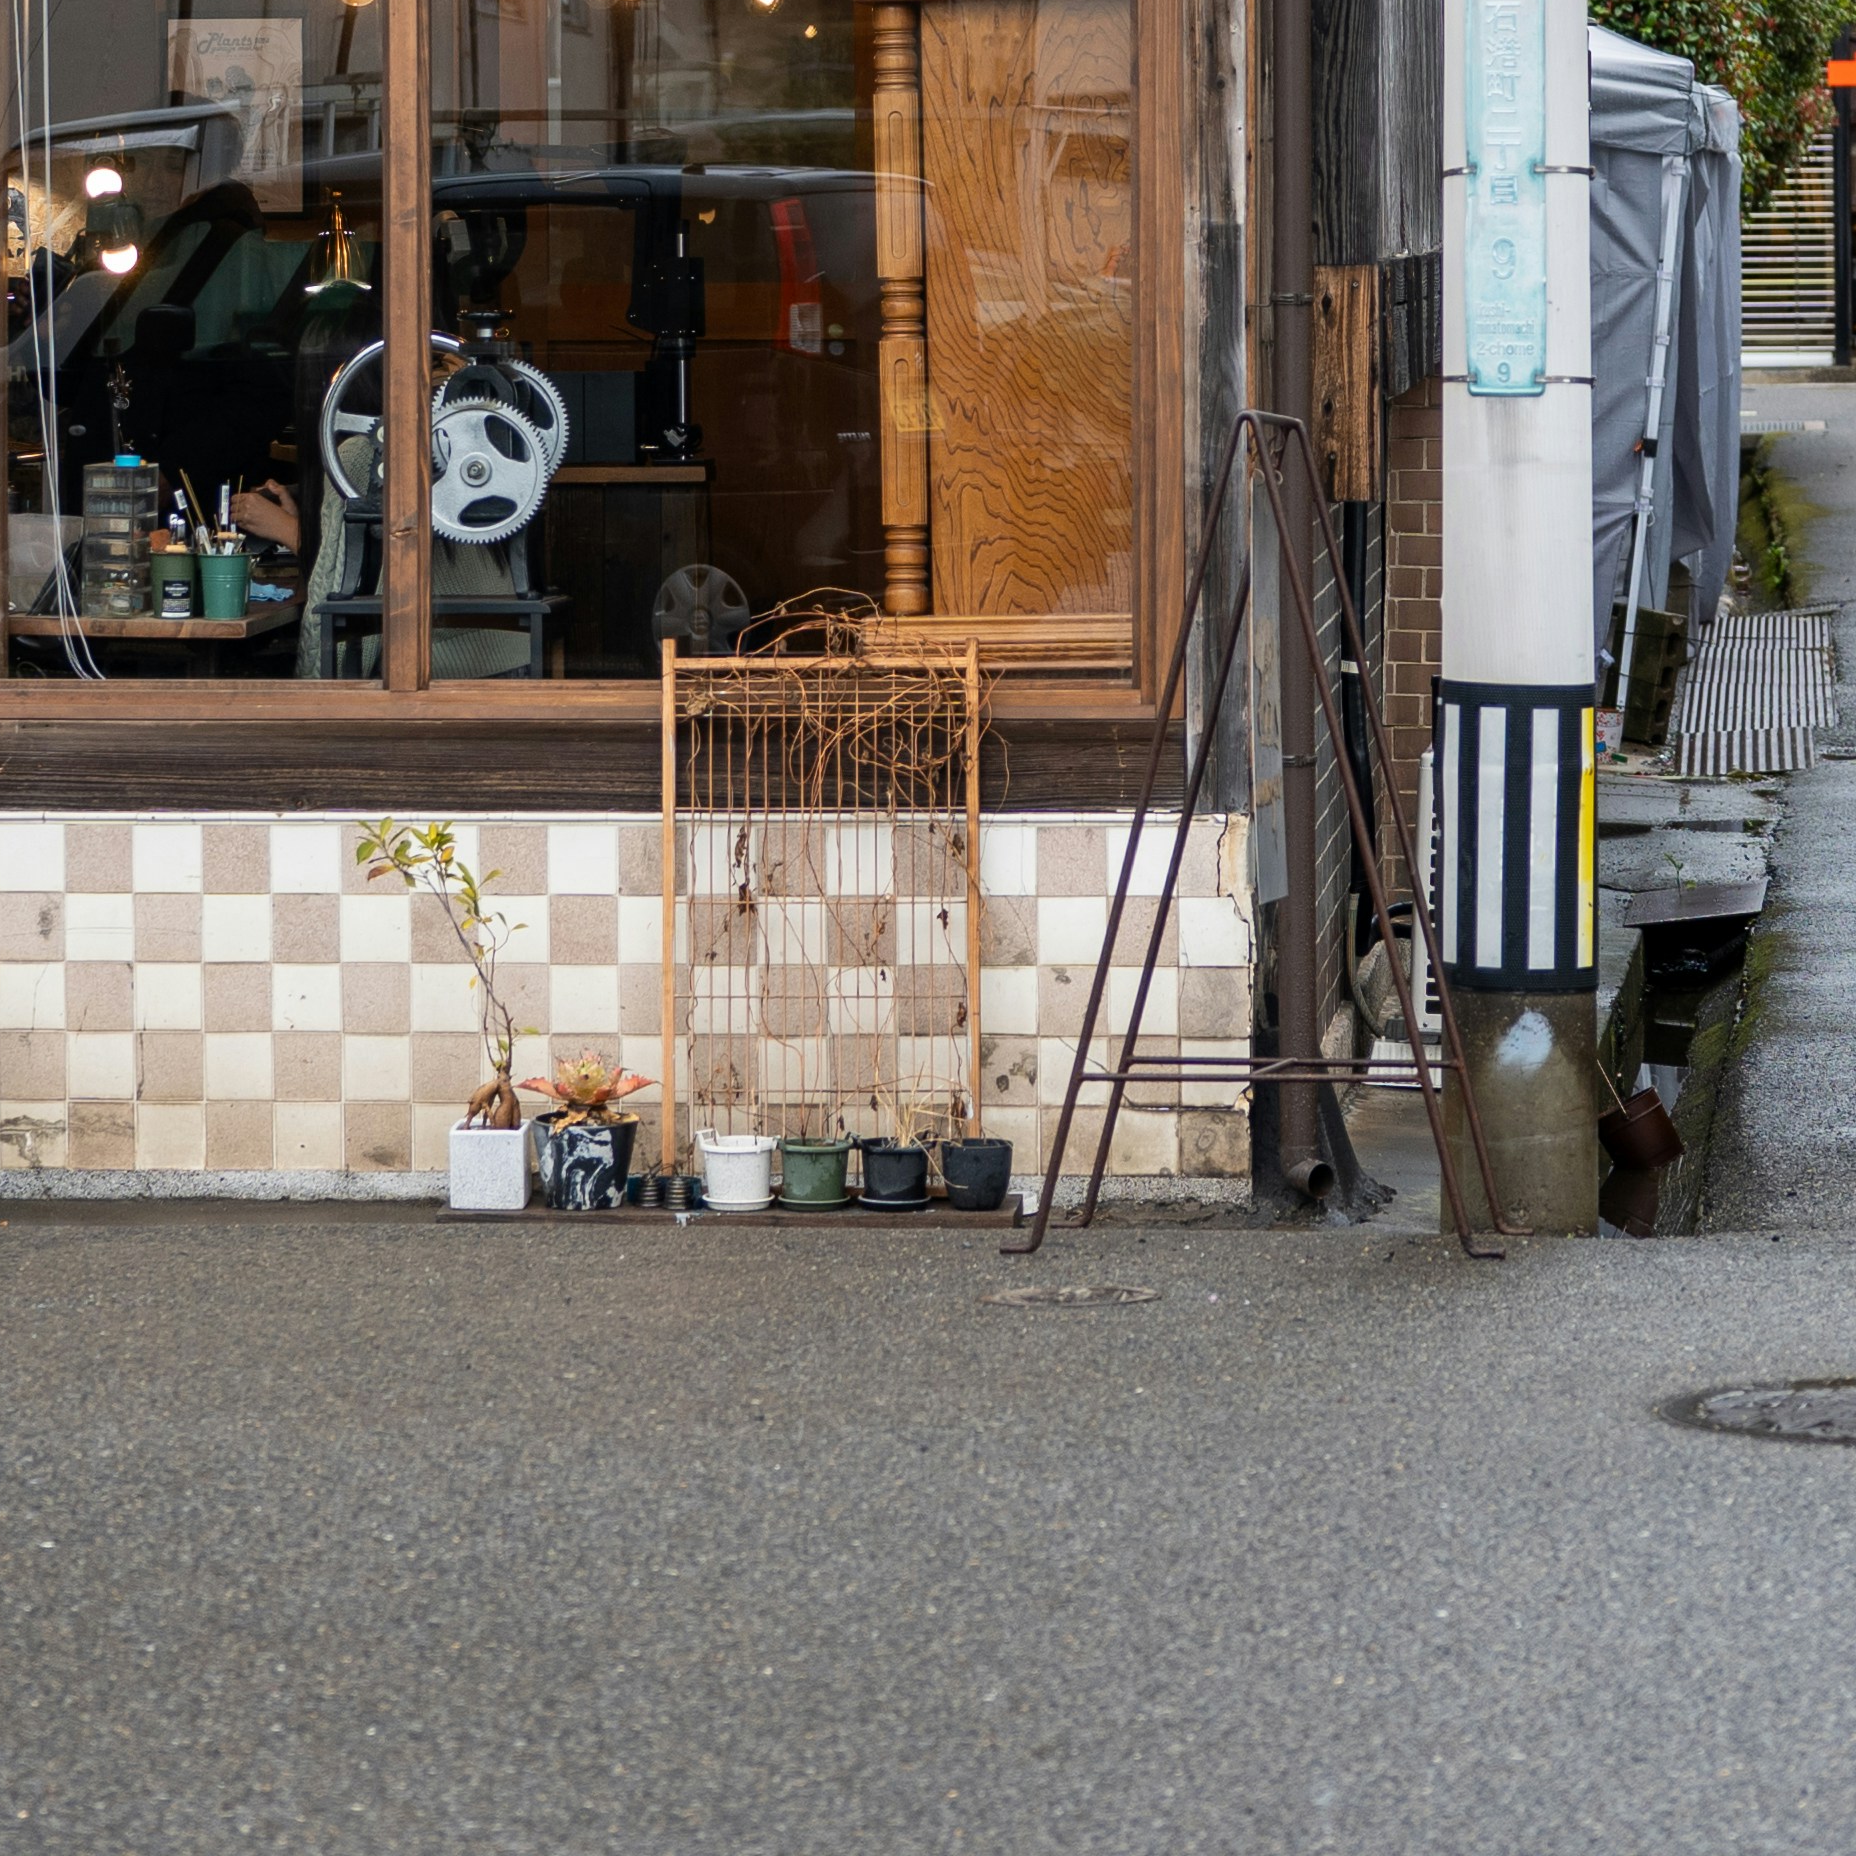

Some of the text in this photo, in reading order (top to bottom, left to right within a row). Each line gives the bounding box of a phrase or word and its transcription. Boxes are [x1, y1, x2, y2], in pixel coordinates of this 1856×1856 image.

[1492, 237, 1516, 280] 9
[1476, 341, 1535, 356] 2-chome
[1497, 362, 1511, 384] 9
